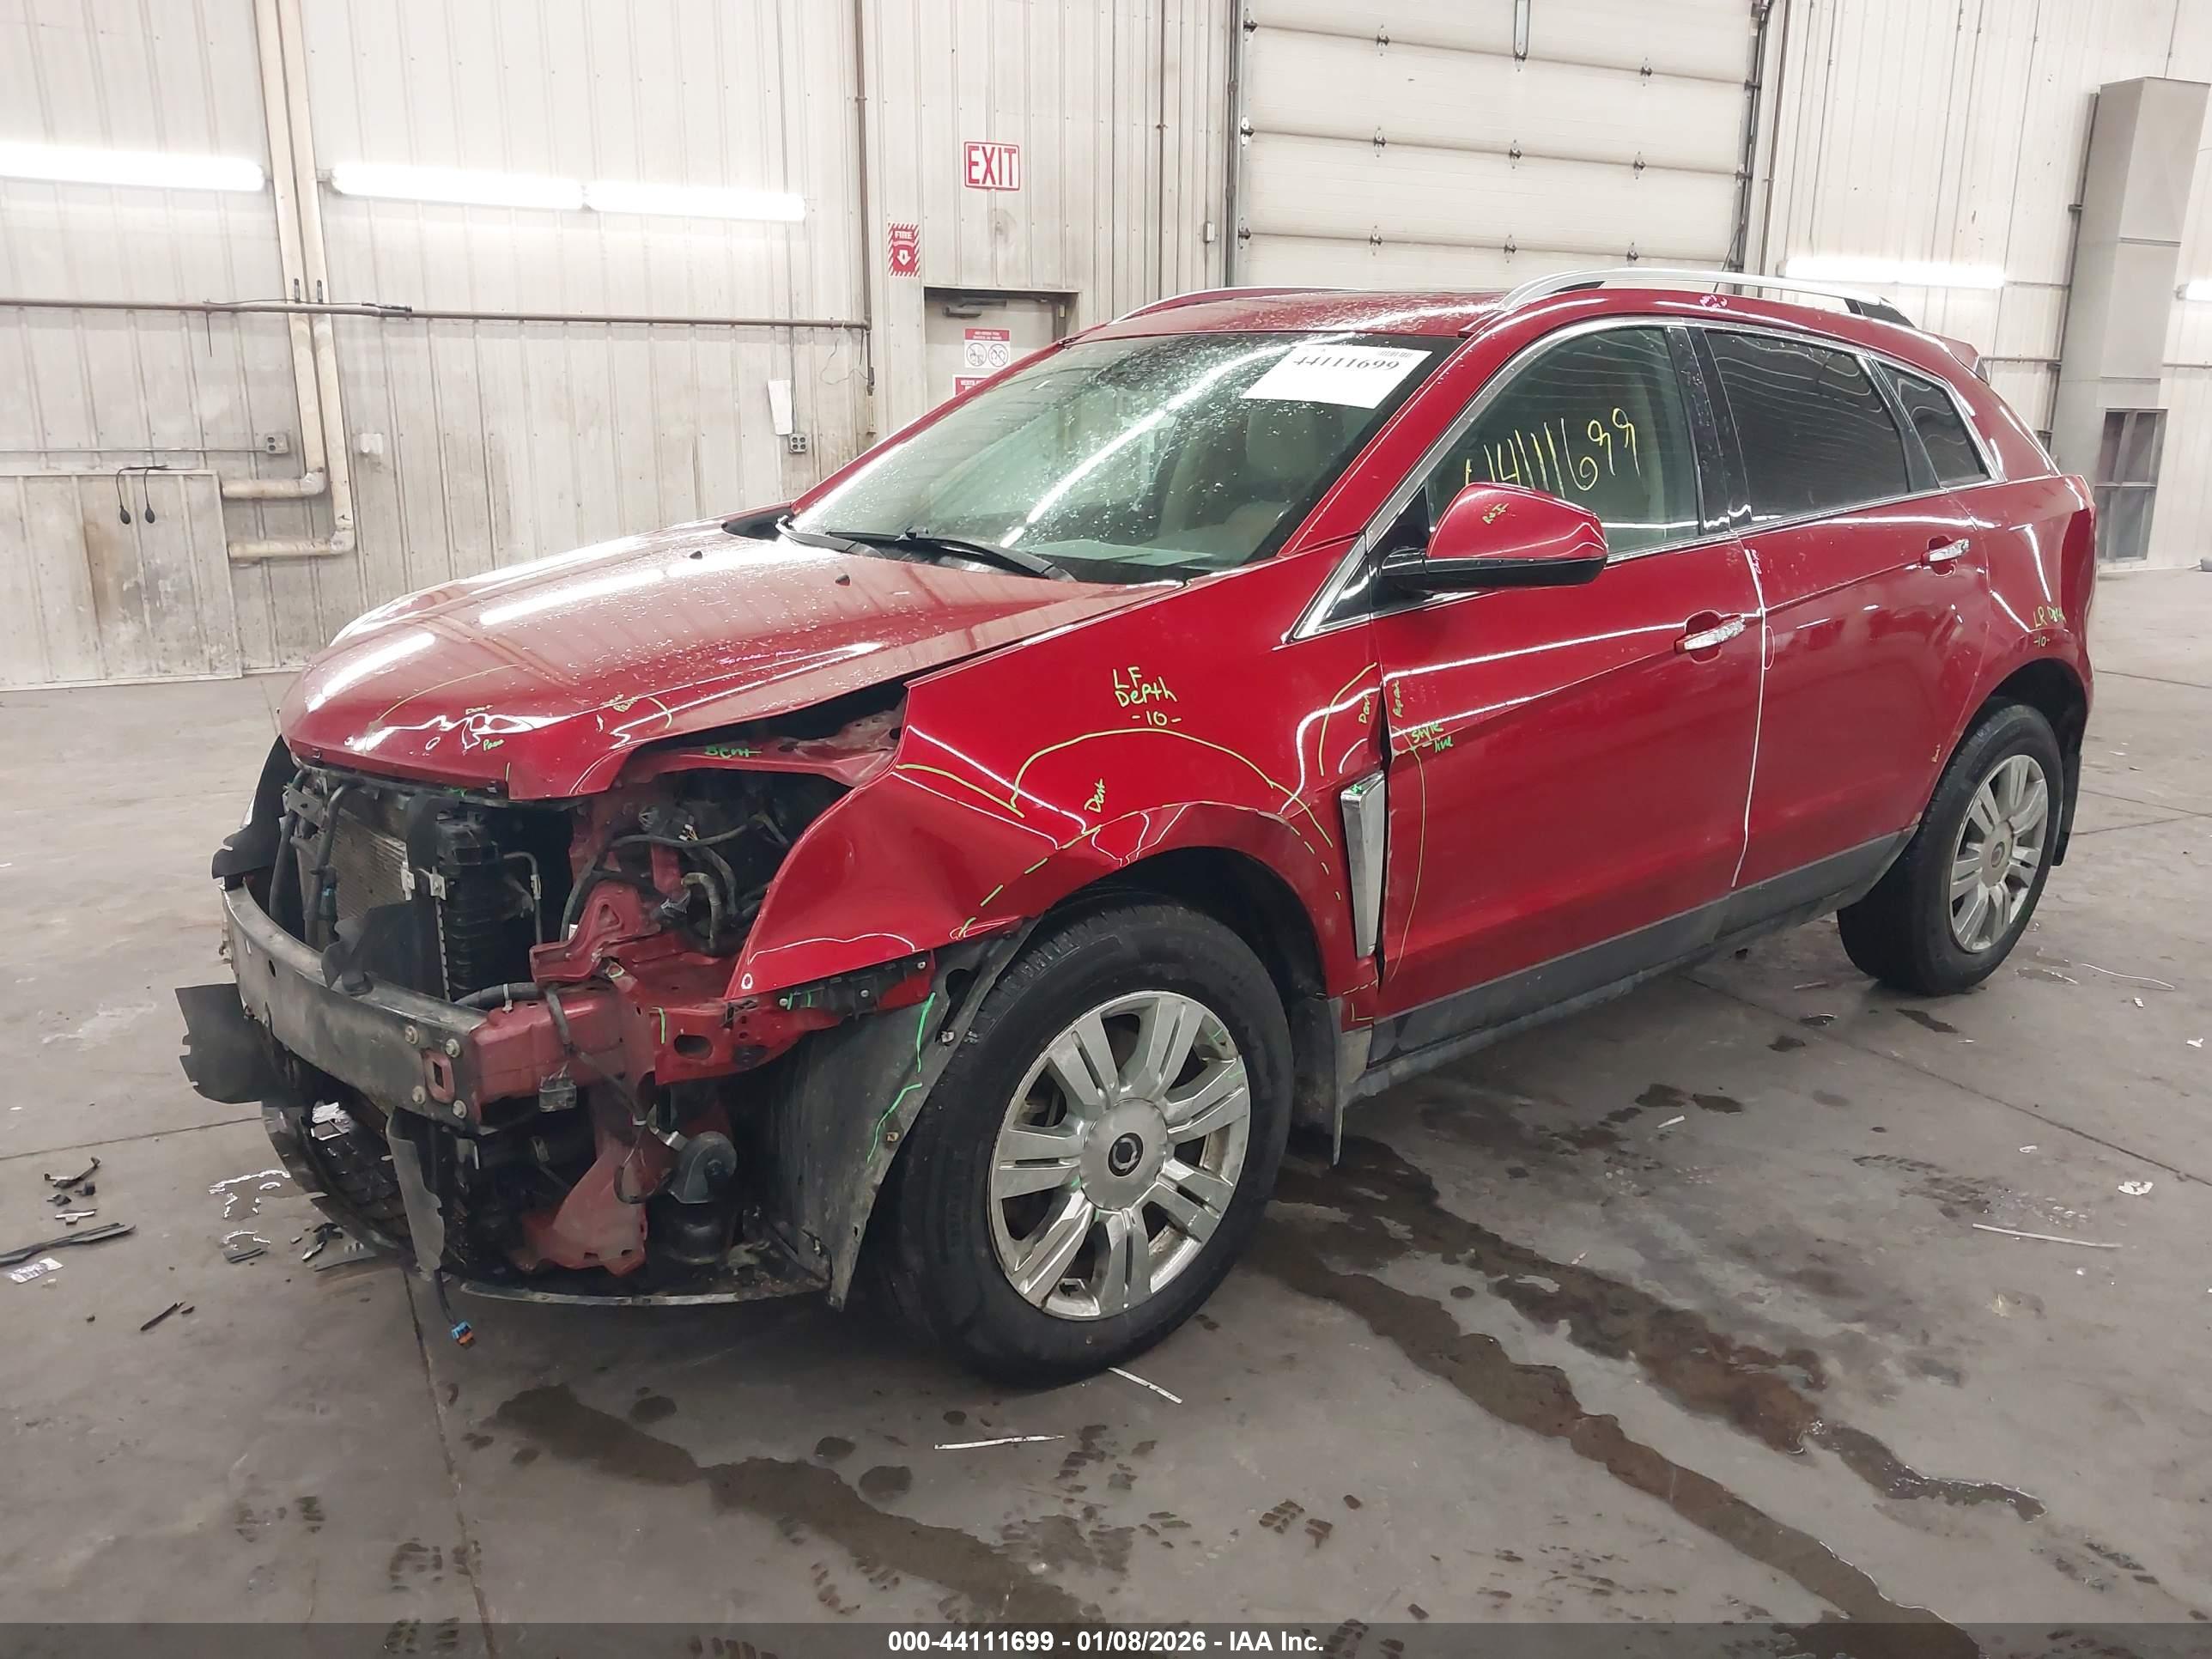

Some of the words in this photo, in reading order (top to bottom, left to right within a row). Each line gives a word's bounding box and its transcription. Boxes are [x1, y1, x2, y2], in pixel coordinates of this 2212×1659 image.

[967, 144, 1017, 187] EXIT
[1293, 356, 1400, 370] 44111699
[1115, 676, 1178, 708] Depth
